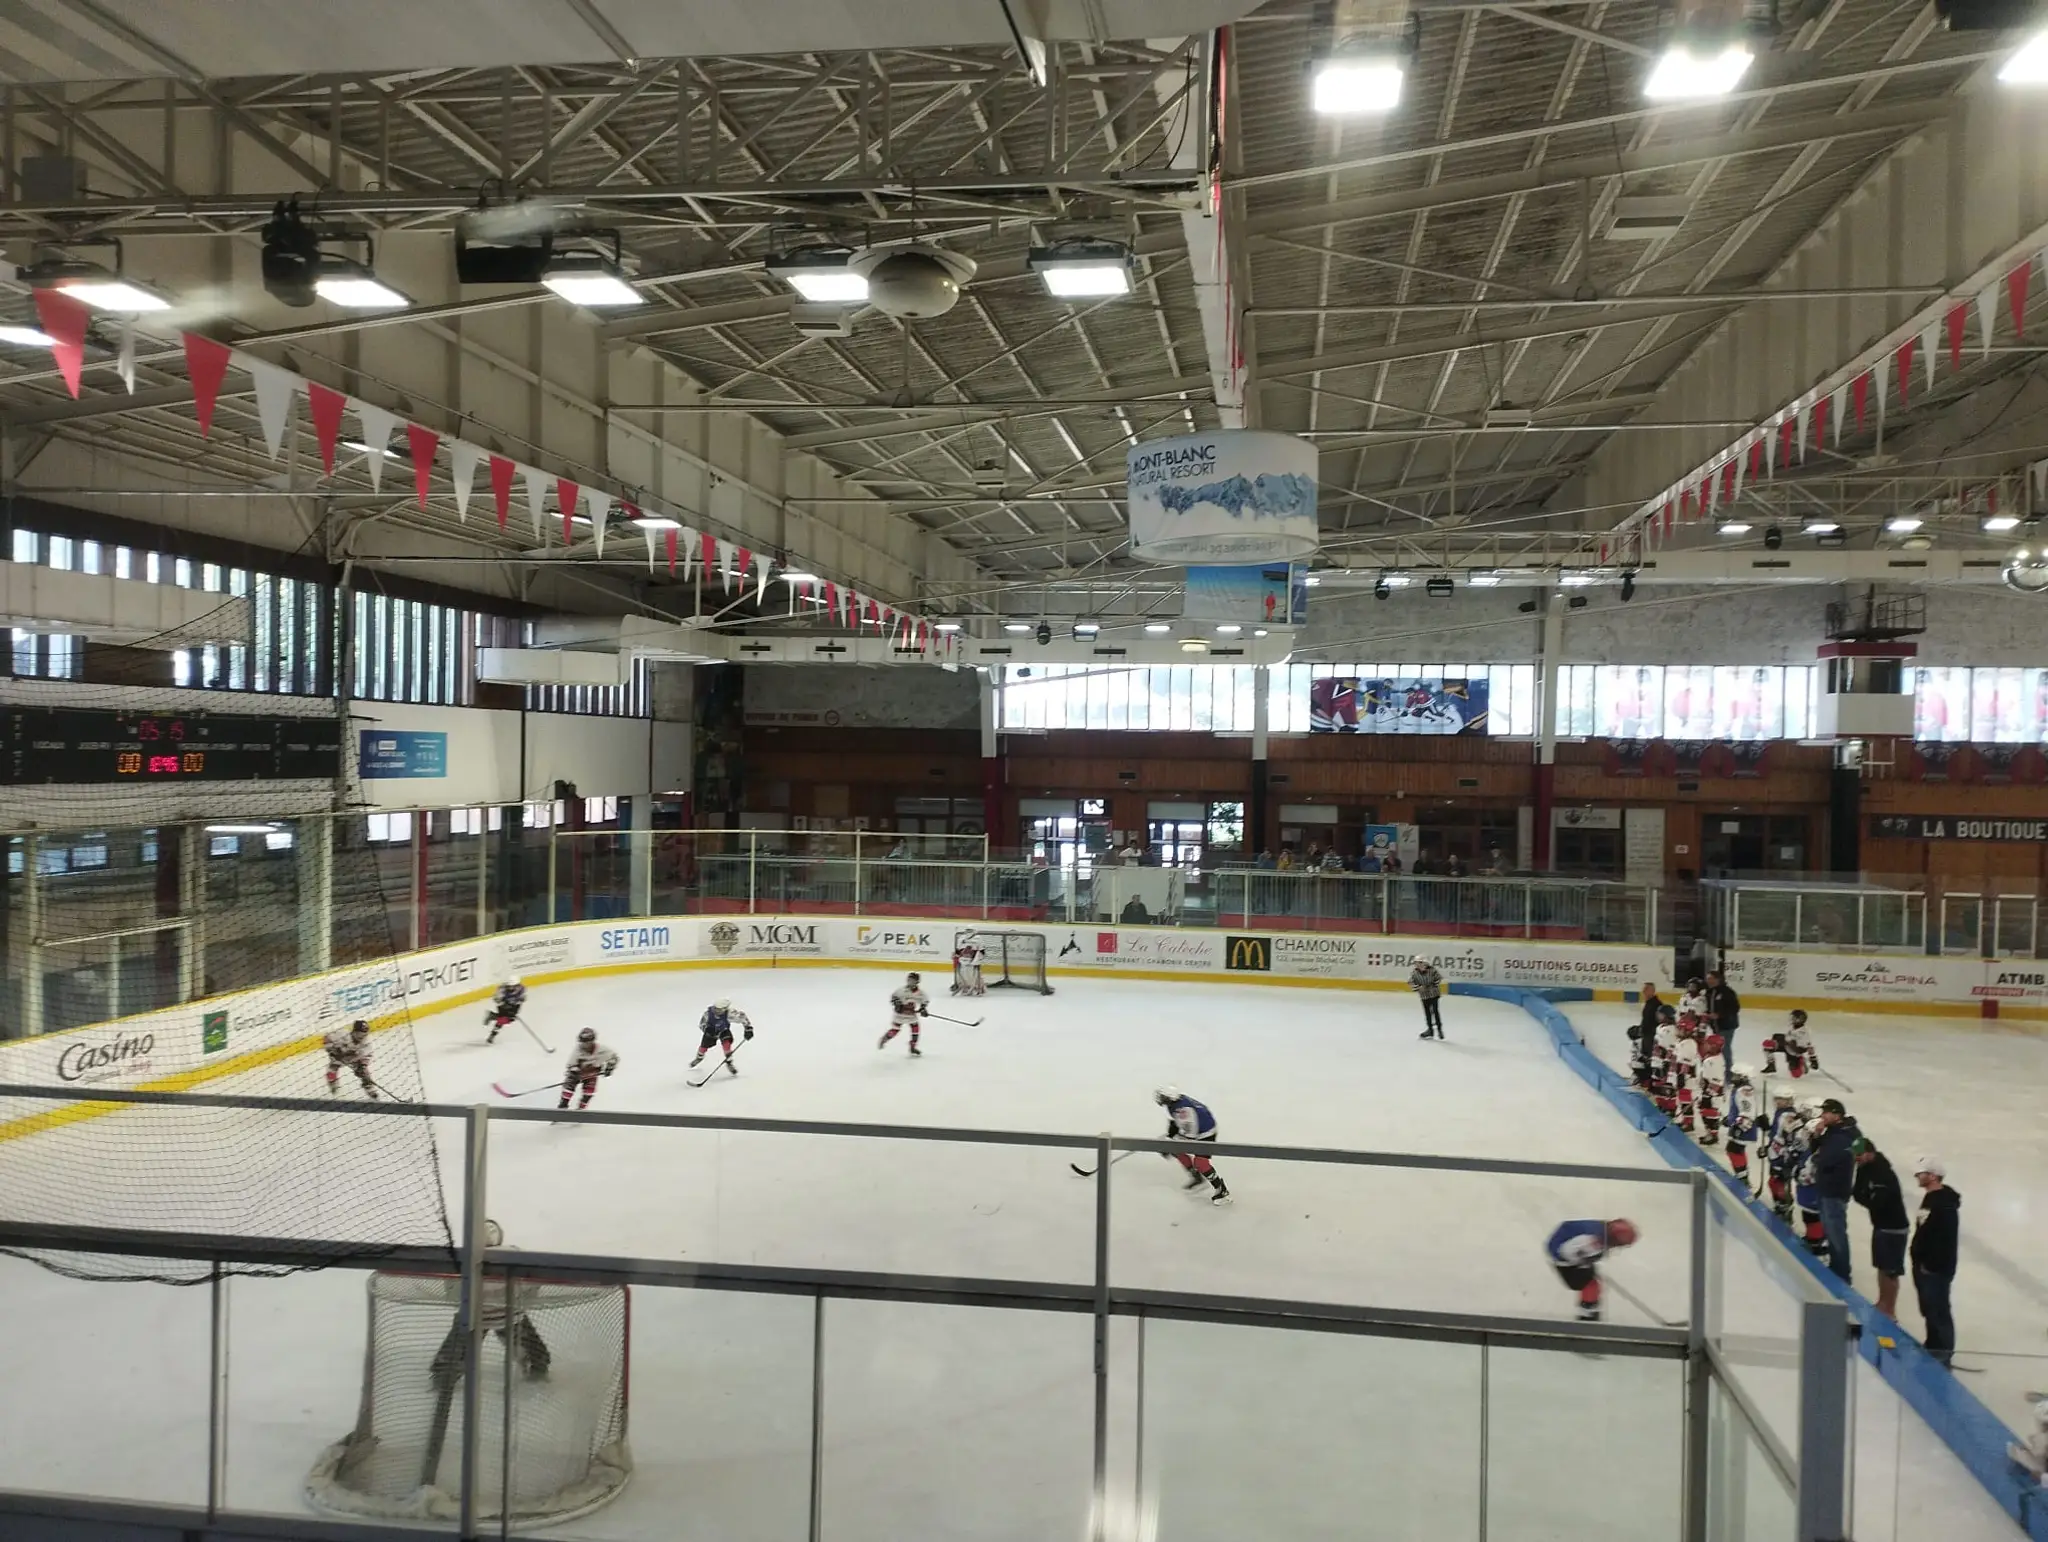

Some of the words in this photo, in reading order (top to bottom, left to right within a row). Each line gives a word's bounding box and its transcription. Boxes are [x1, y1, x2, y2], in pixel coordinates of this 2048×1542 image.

[1170, 461, 1216, 479] RESORT
[1922, 820, 1945, 837] LA
[1957, 821, 2047, 839] BOUTIQUE
[601, 926, 669, 949] SETAM
[749, 925, 820, 944] MGM
[884, 933, 930, 946] PEAK
[1275, 938, 1356, 953] CHAMONIX
[1147, 958, 1182, 966] CHAMONIX
[1504, 959, 1571, 971] SOLUTIONS
[1575, 962, 1638, 974] GLOBALES
[1997, 973, 2044, 985] ATMB
[233, 1008, 292, 1031] Groupama
[57, 1031, 154, 1081] Casino
